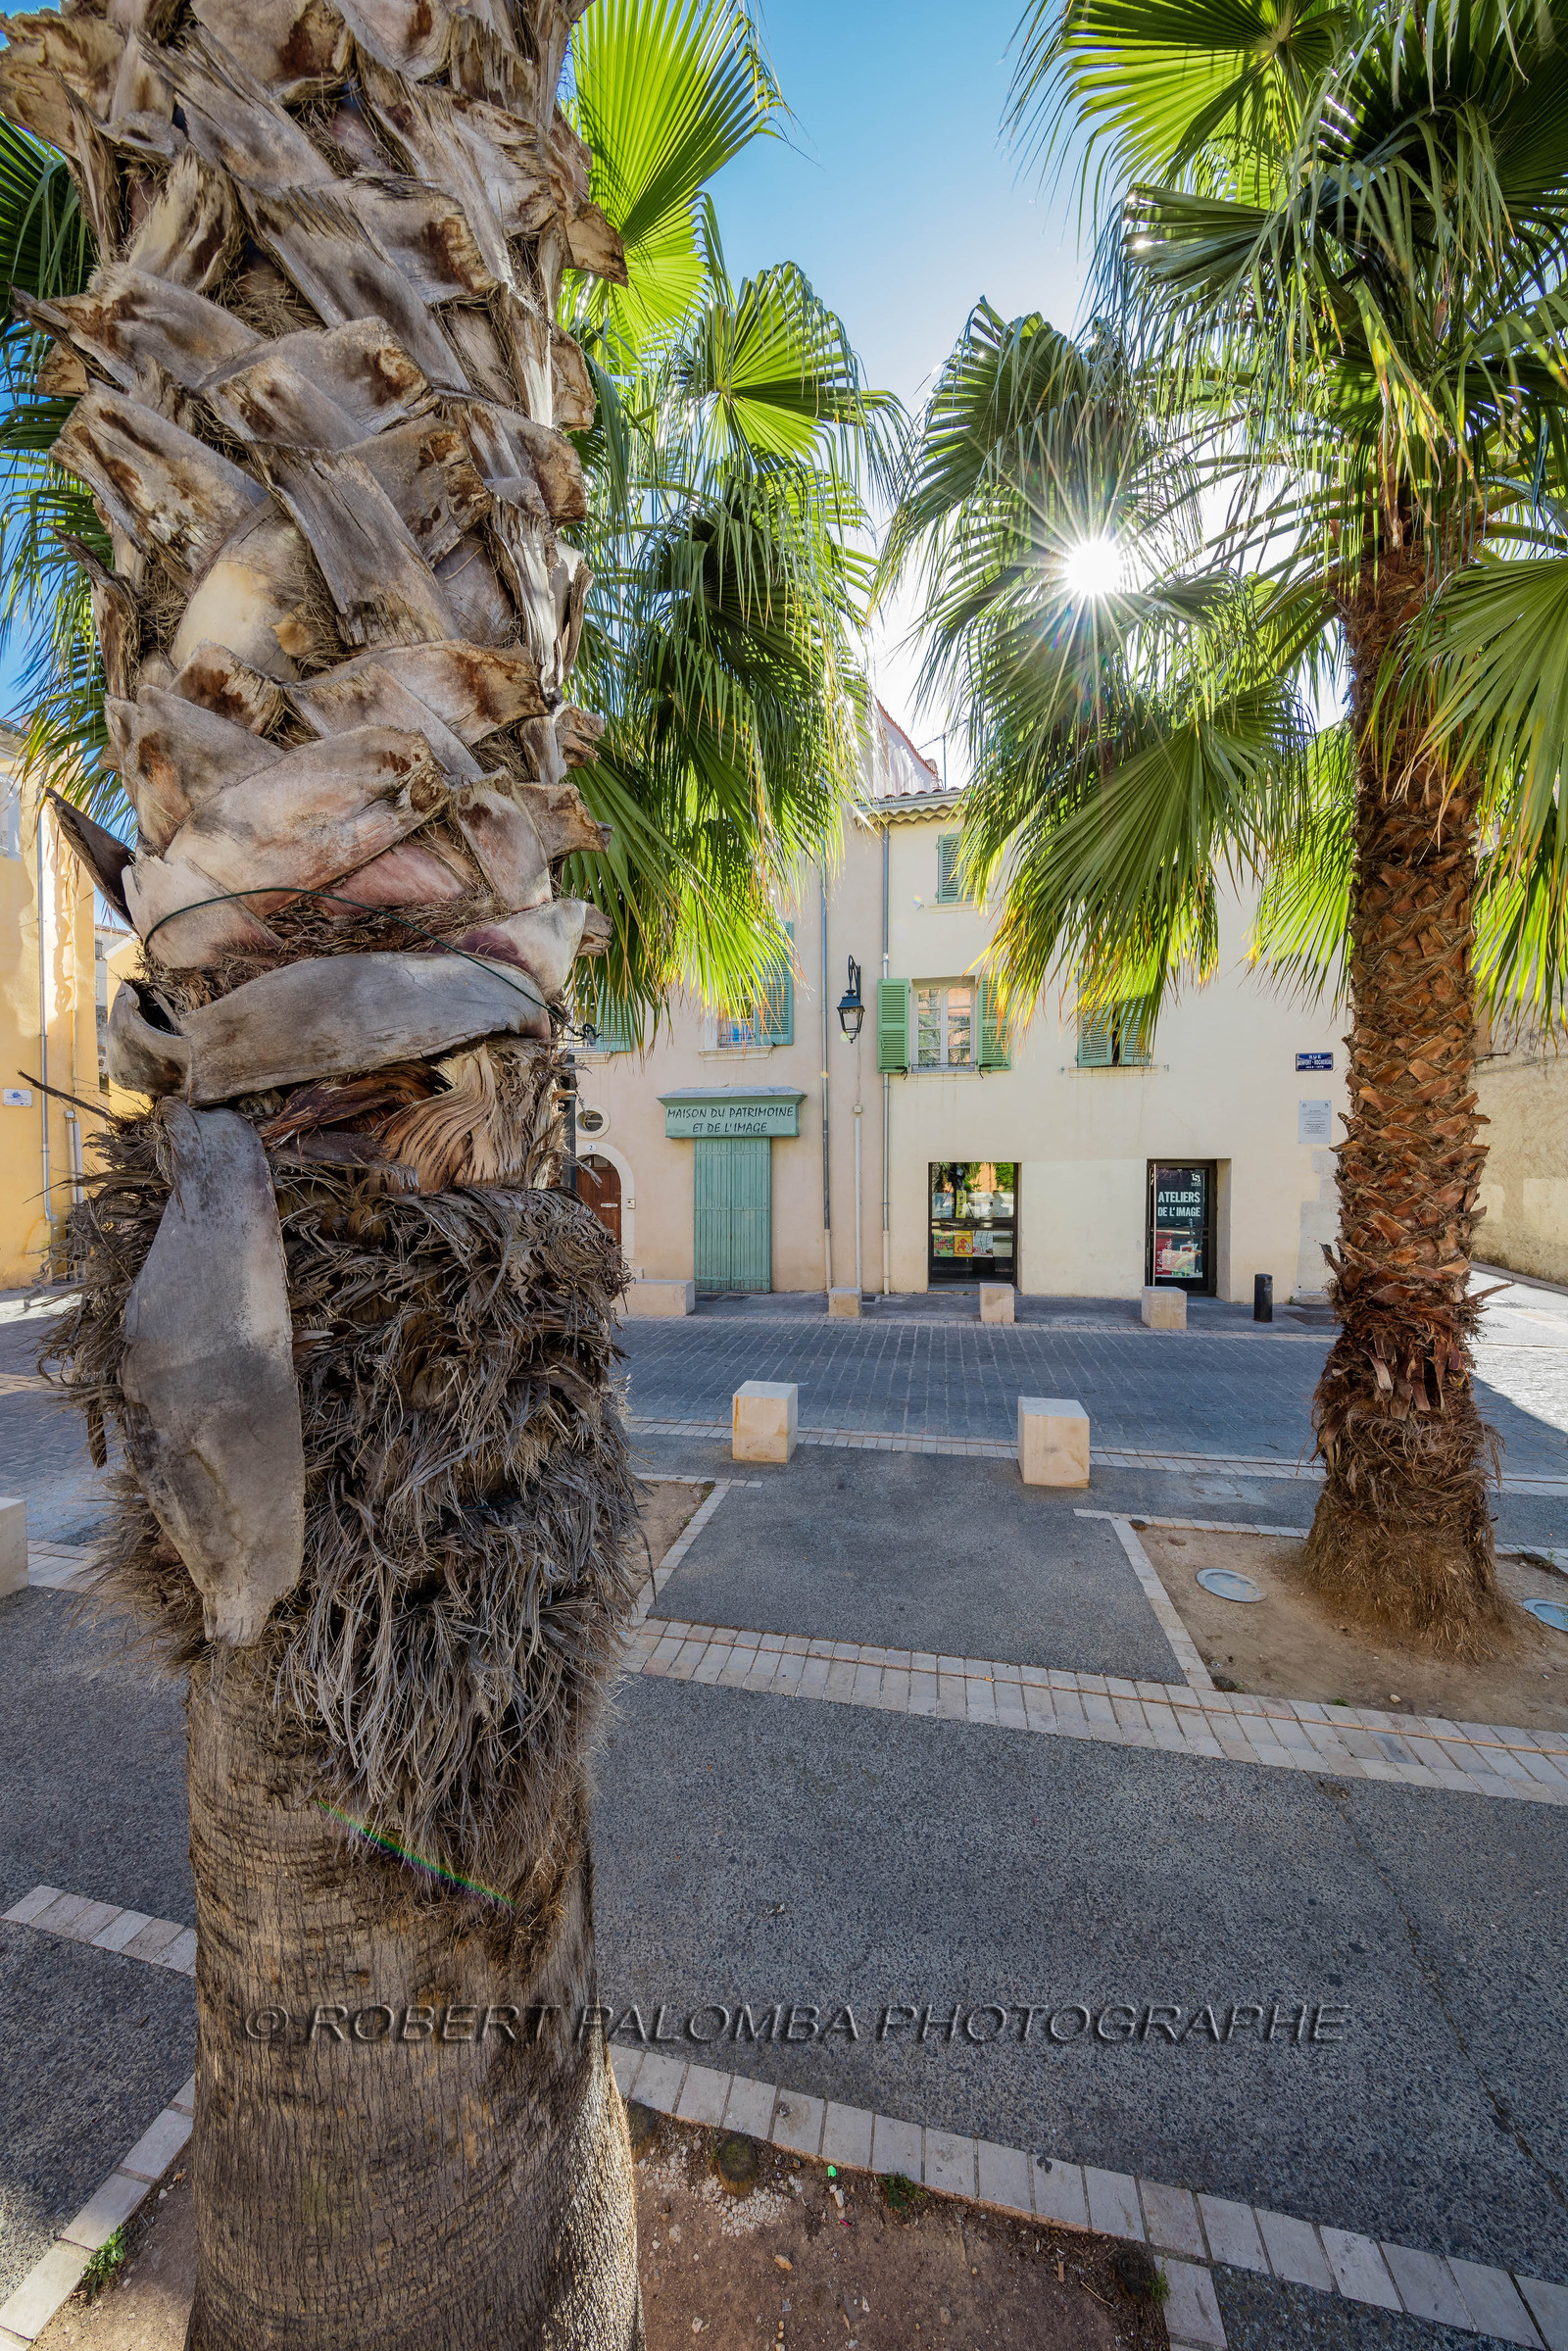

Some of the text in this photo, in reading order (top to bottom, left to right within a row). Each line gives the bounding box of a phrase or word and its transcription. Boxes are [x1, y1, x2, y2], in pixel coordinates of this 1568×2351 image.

[667, 1106, 794, 1118] MAISON DU PATRIMOINE
[693, 1122, 767, 1133] ET DE L'IMAGE
[1157, 1192, 1200, 1202] ATELIERS
[1157, 1206, 1201, 1217] DE L'IMAGE
